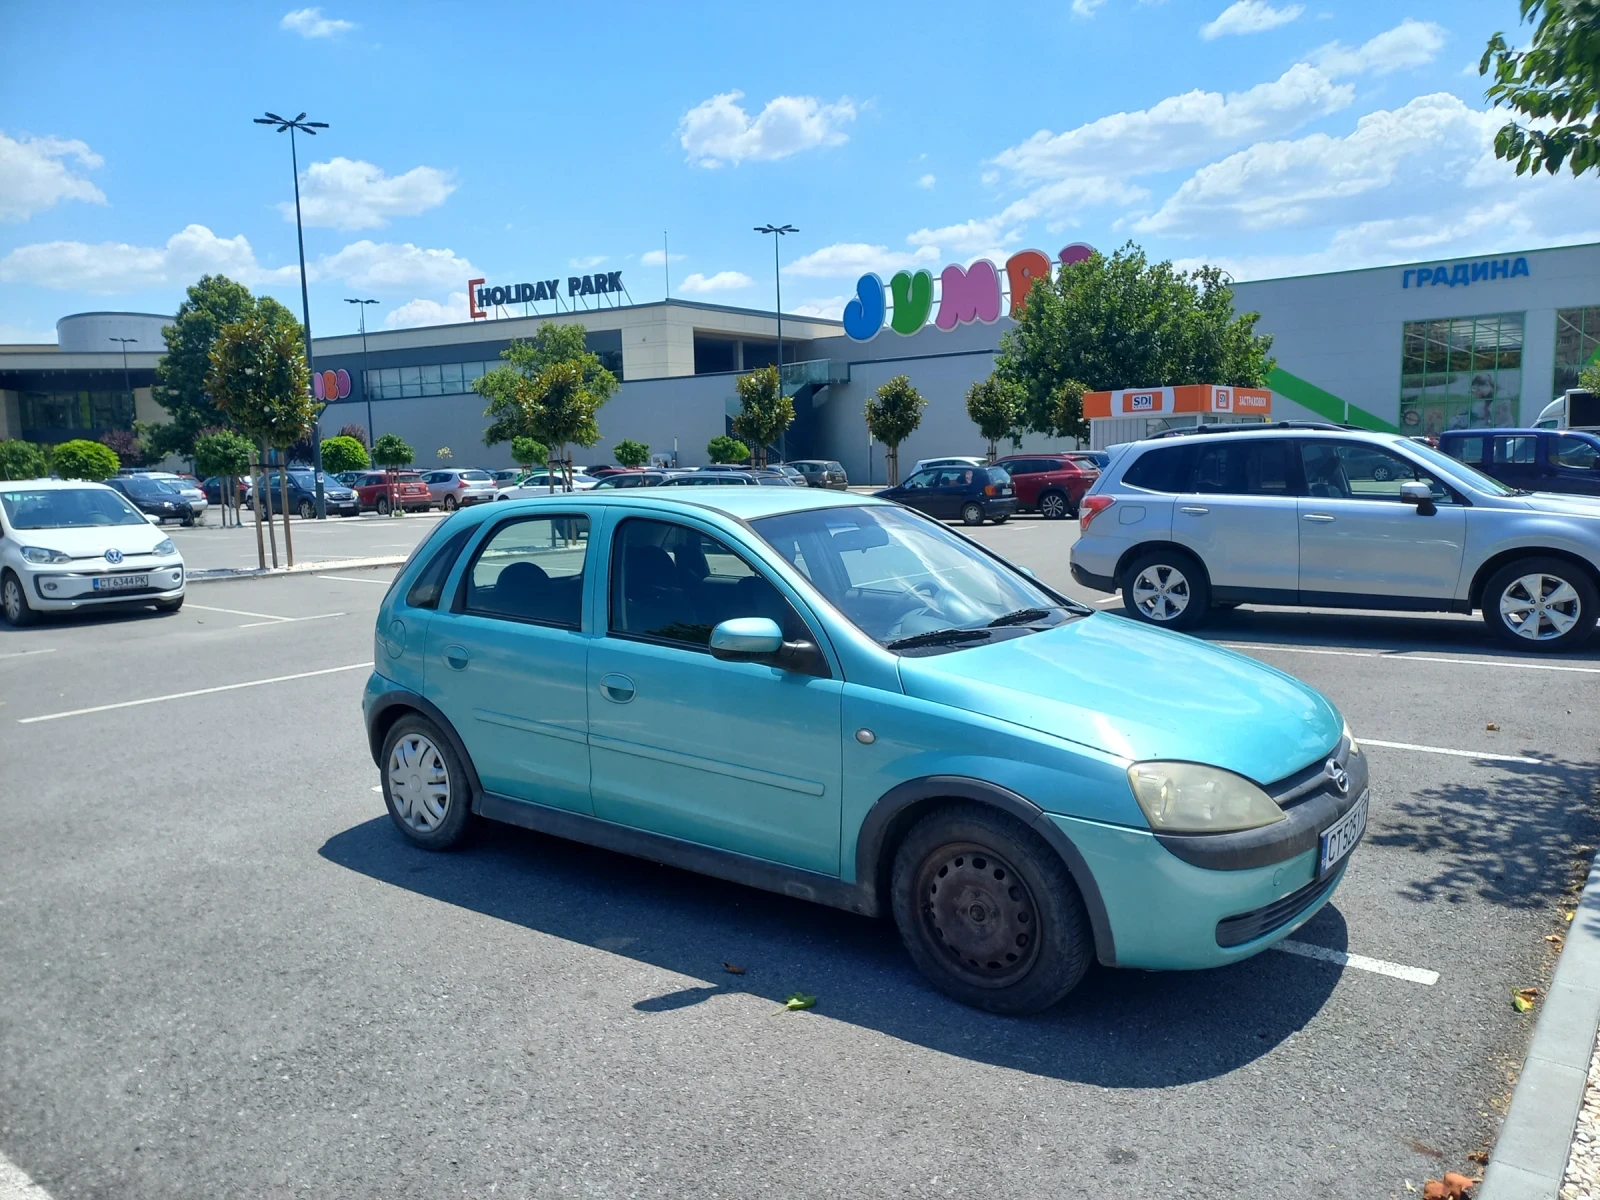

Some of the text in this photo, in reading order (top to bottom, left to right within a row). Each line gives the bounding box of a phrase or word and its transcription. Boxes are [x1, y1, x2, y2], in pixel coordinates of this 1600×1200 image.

[477, 271, 623, 307] HOLIDAY PARK
[1402, 257, 1530, 289] ГРАДИНА
[1134, 396, 1151, 405] SDI
[100, 576, 145, 587] CT 6344 PK
[1329, 829, 1342, 861] CT
